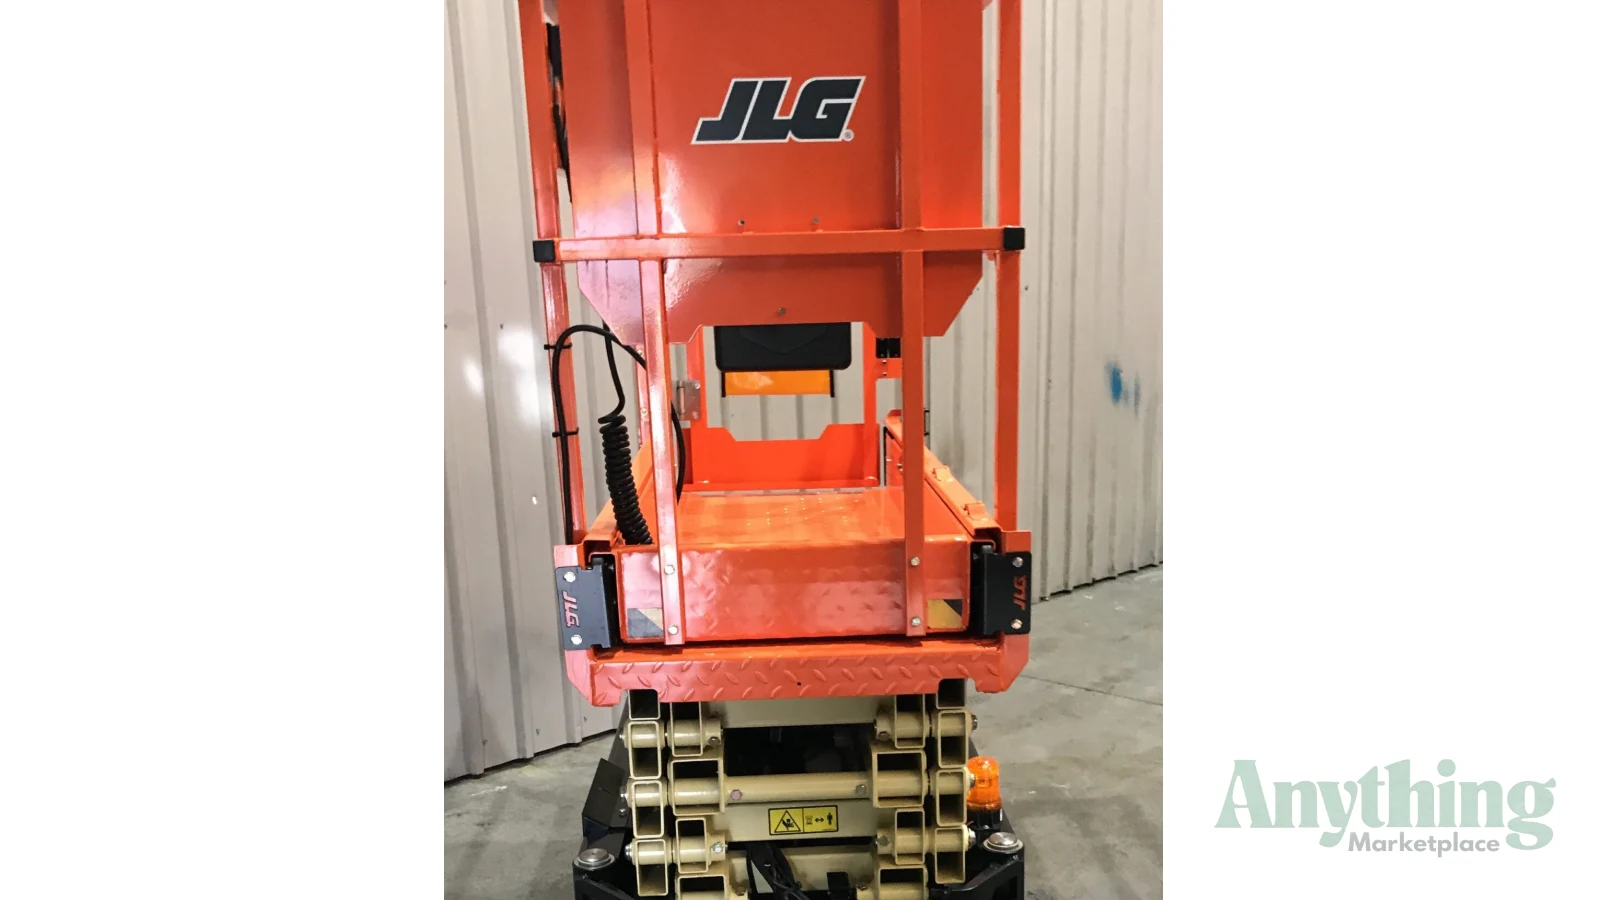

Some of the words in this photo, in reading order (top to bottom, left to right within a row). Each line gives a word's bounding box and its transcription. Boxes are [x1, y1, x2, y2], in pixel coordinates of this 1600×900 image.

[693, 77, 864, 143] JLG
[563, 591, 579, 628] JLG
[1013, 575, 1027, 610] JLG
